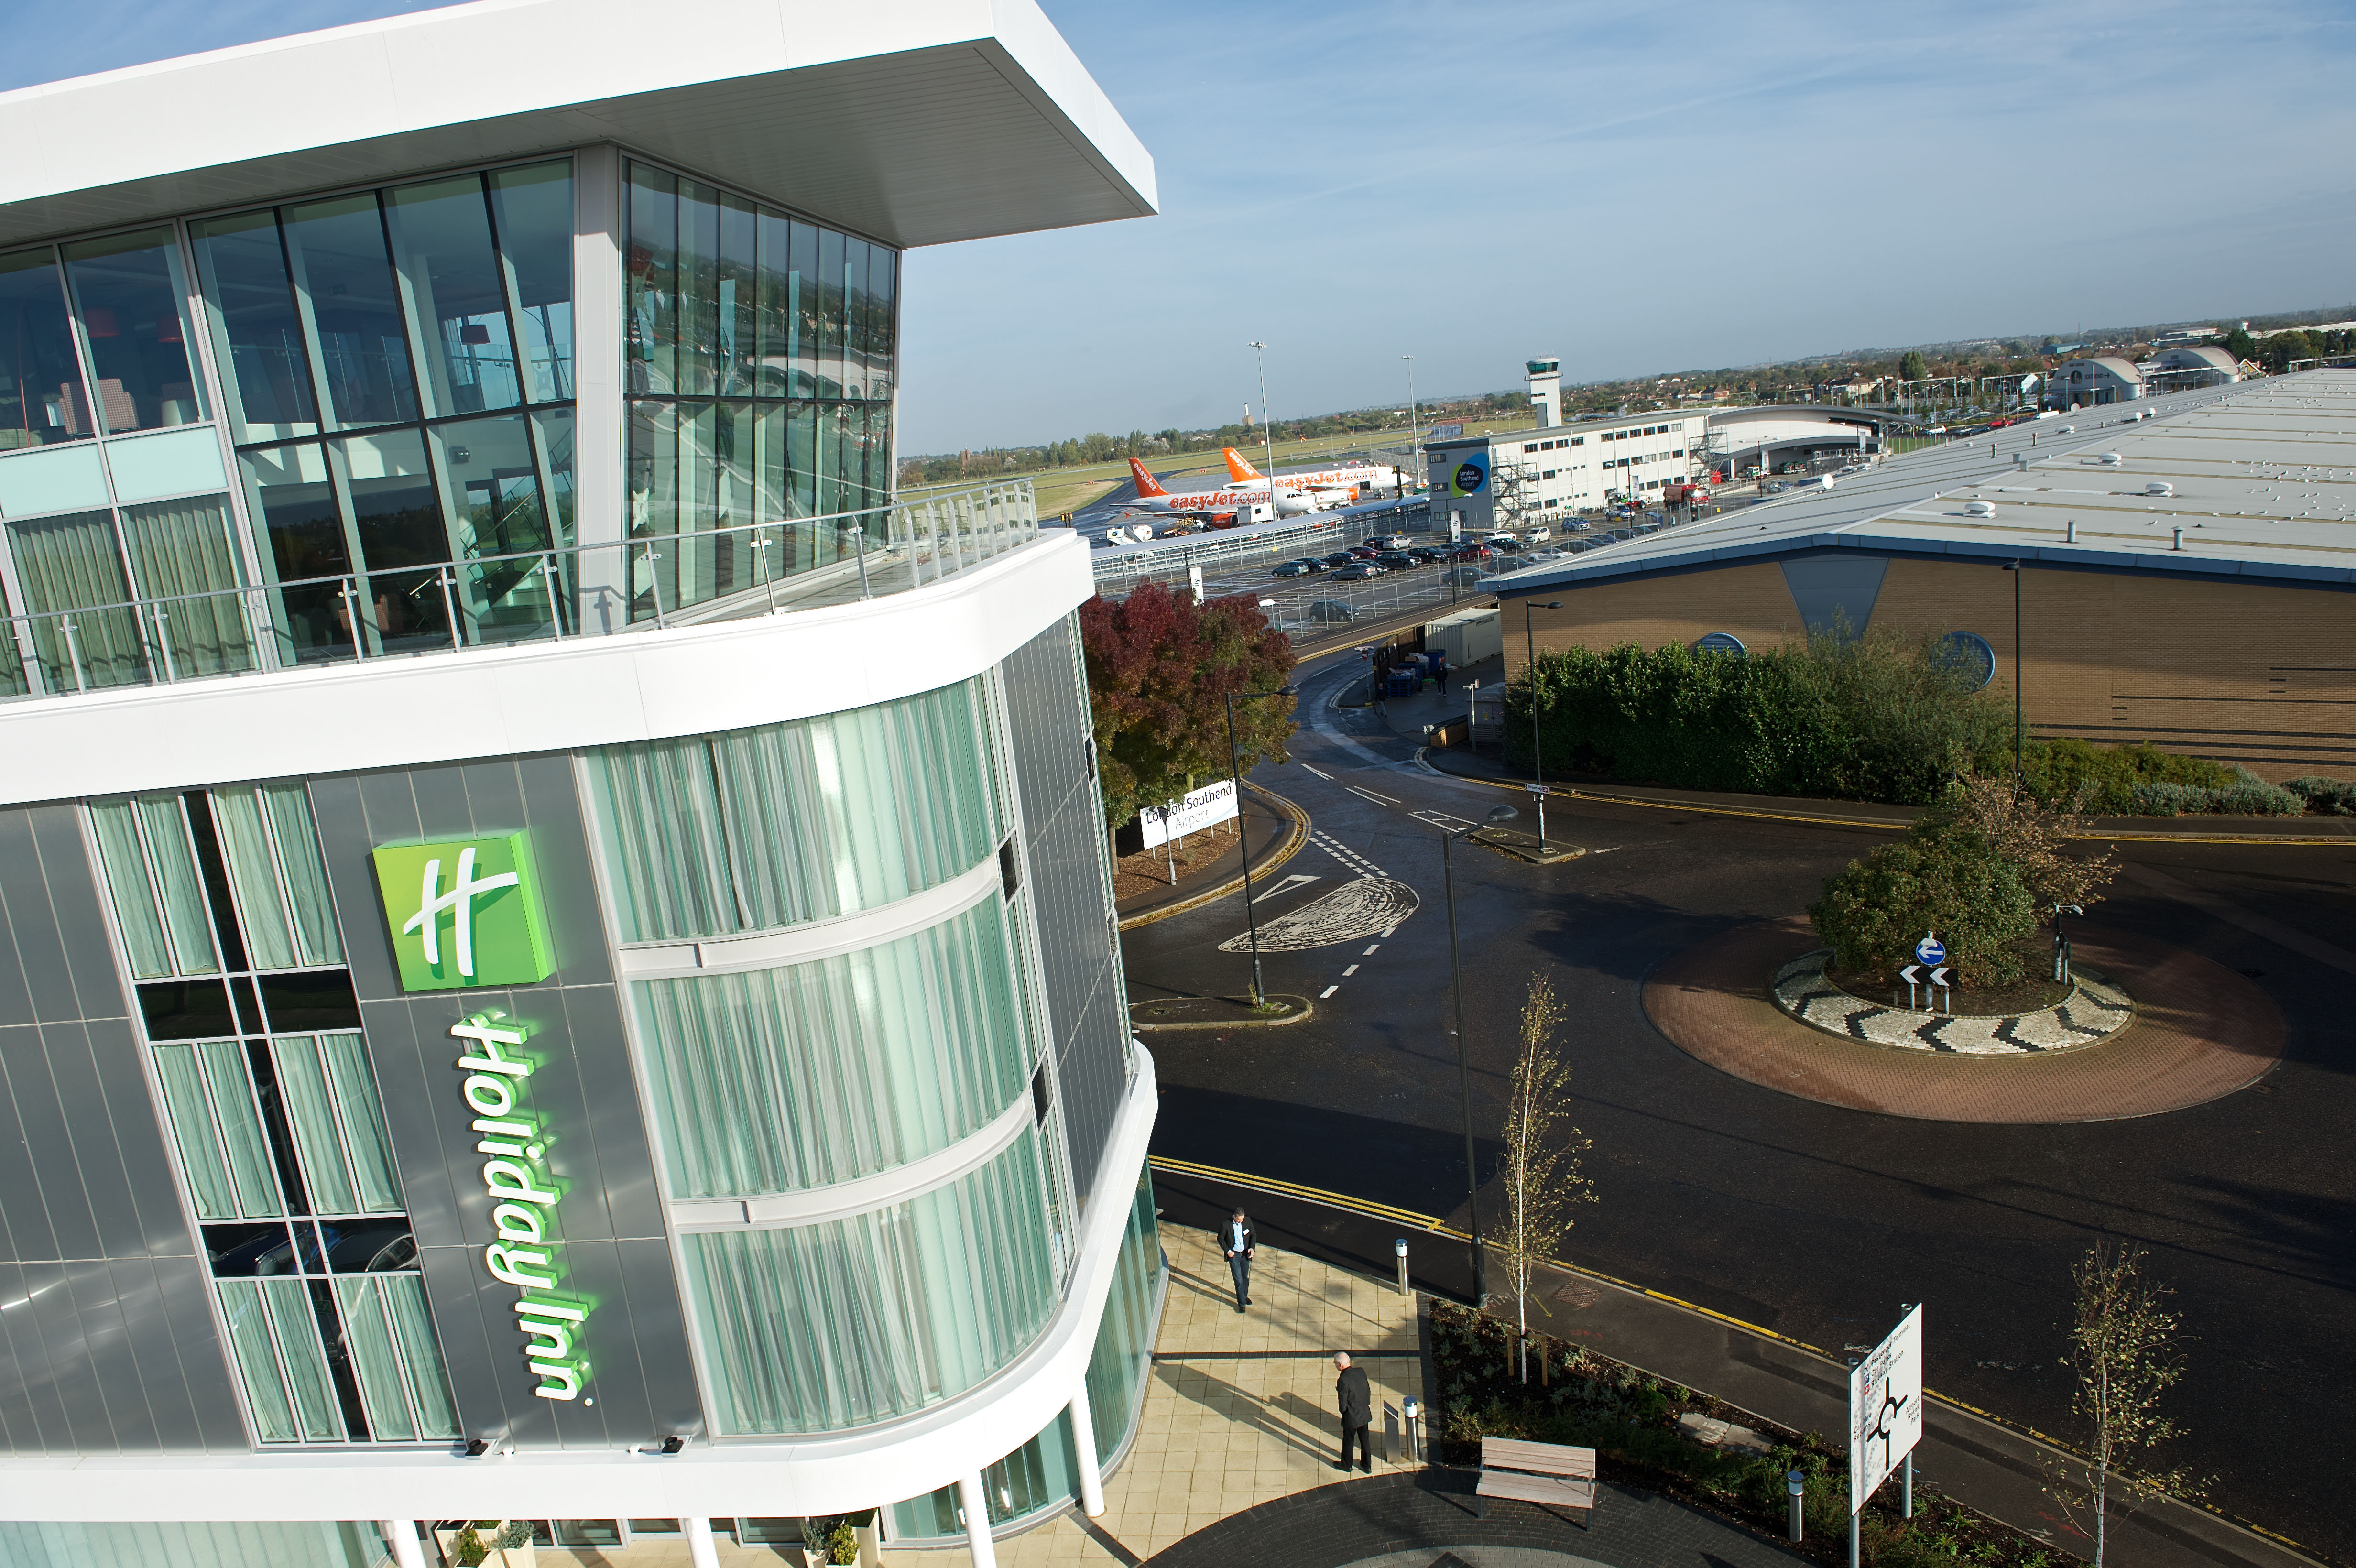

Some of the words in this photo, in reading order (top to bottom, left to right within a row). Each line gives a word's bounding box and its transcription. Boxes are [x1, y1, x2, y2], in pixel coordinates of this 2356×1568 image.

[1229, 452, 1254, 476] easyJet
[1134, 463, 1157, 492] easyJet
[1275, 469, 1377, 490] easyJet.com
[1170, 491, 1270, 511] easyJet.com
[1187, 783, 1232, 810] Southend
[1175, 807, 1209, 830] Airport
[451, 1013, 561, 1291] Holiday
[515, 1295, 589, 1401] Inn
[1871, 1341, 1892, 1366] Passenger
[1893, 1322, 1910, 1342] Terminal
[1889, 1350, 1904, 1370] Station
[1906, 1396, 1919, 1415] Airport
